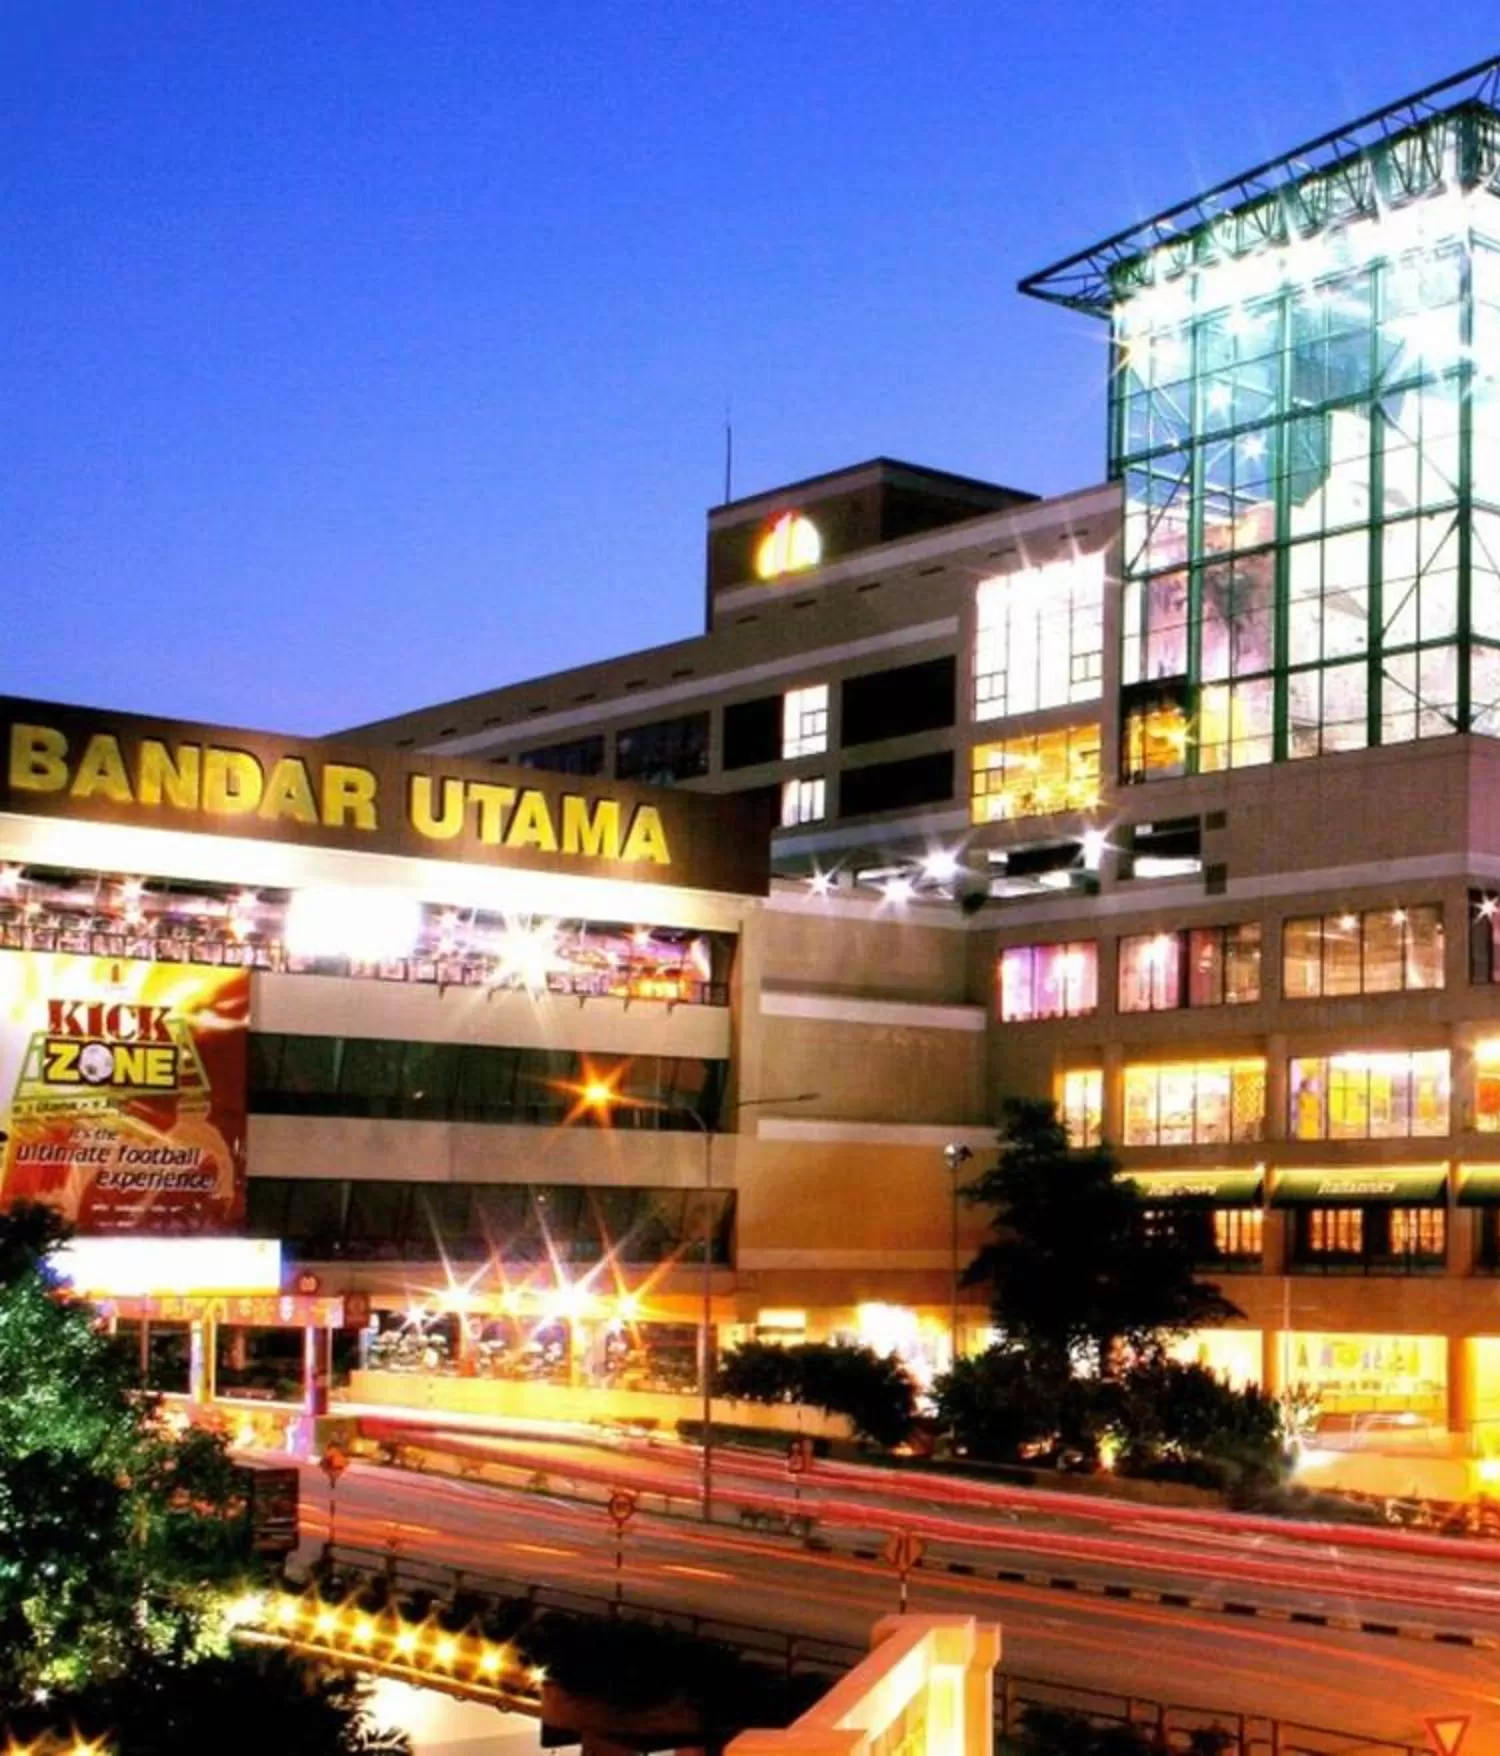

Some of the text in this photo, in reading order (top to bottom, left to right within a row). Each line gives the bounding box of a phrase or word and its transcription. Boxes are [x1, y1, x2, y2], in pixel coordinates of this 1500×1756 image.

[9, 722, 671, 865] BANDAR UTAMA
[48, 999, 172, 1042] KICK
[48, 1043, 175, 1085] ZONE
[17, 1143, 200, 1166] ultimate football
[96, 1168, 211, 1191] experience
